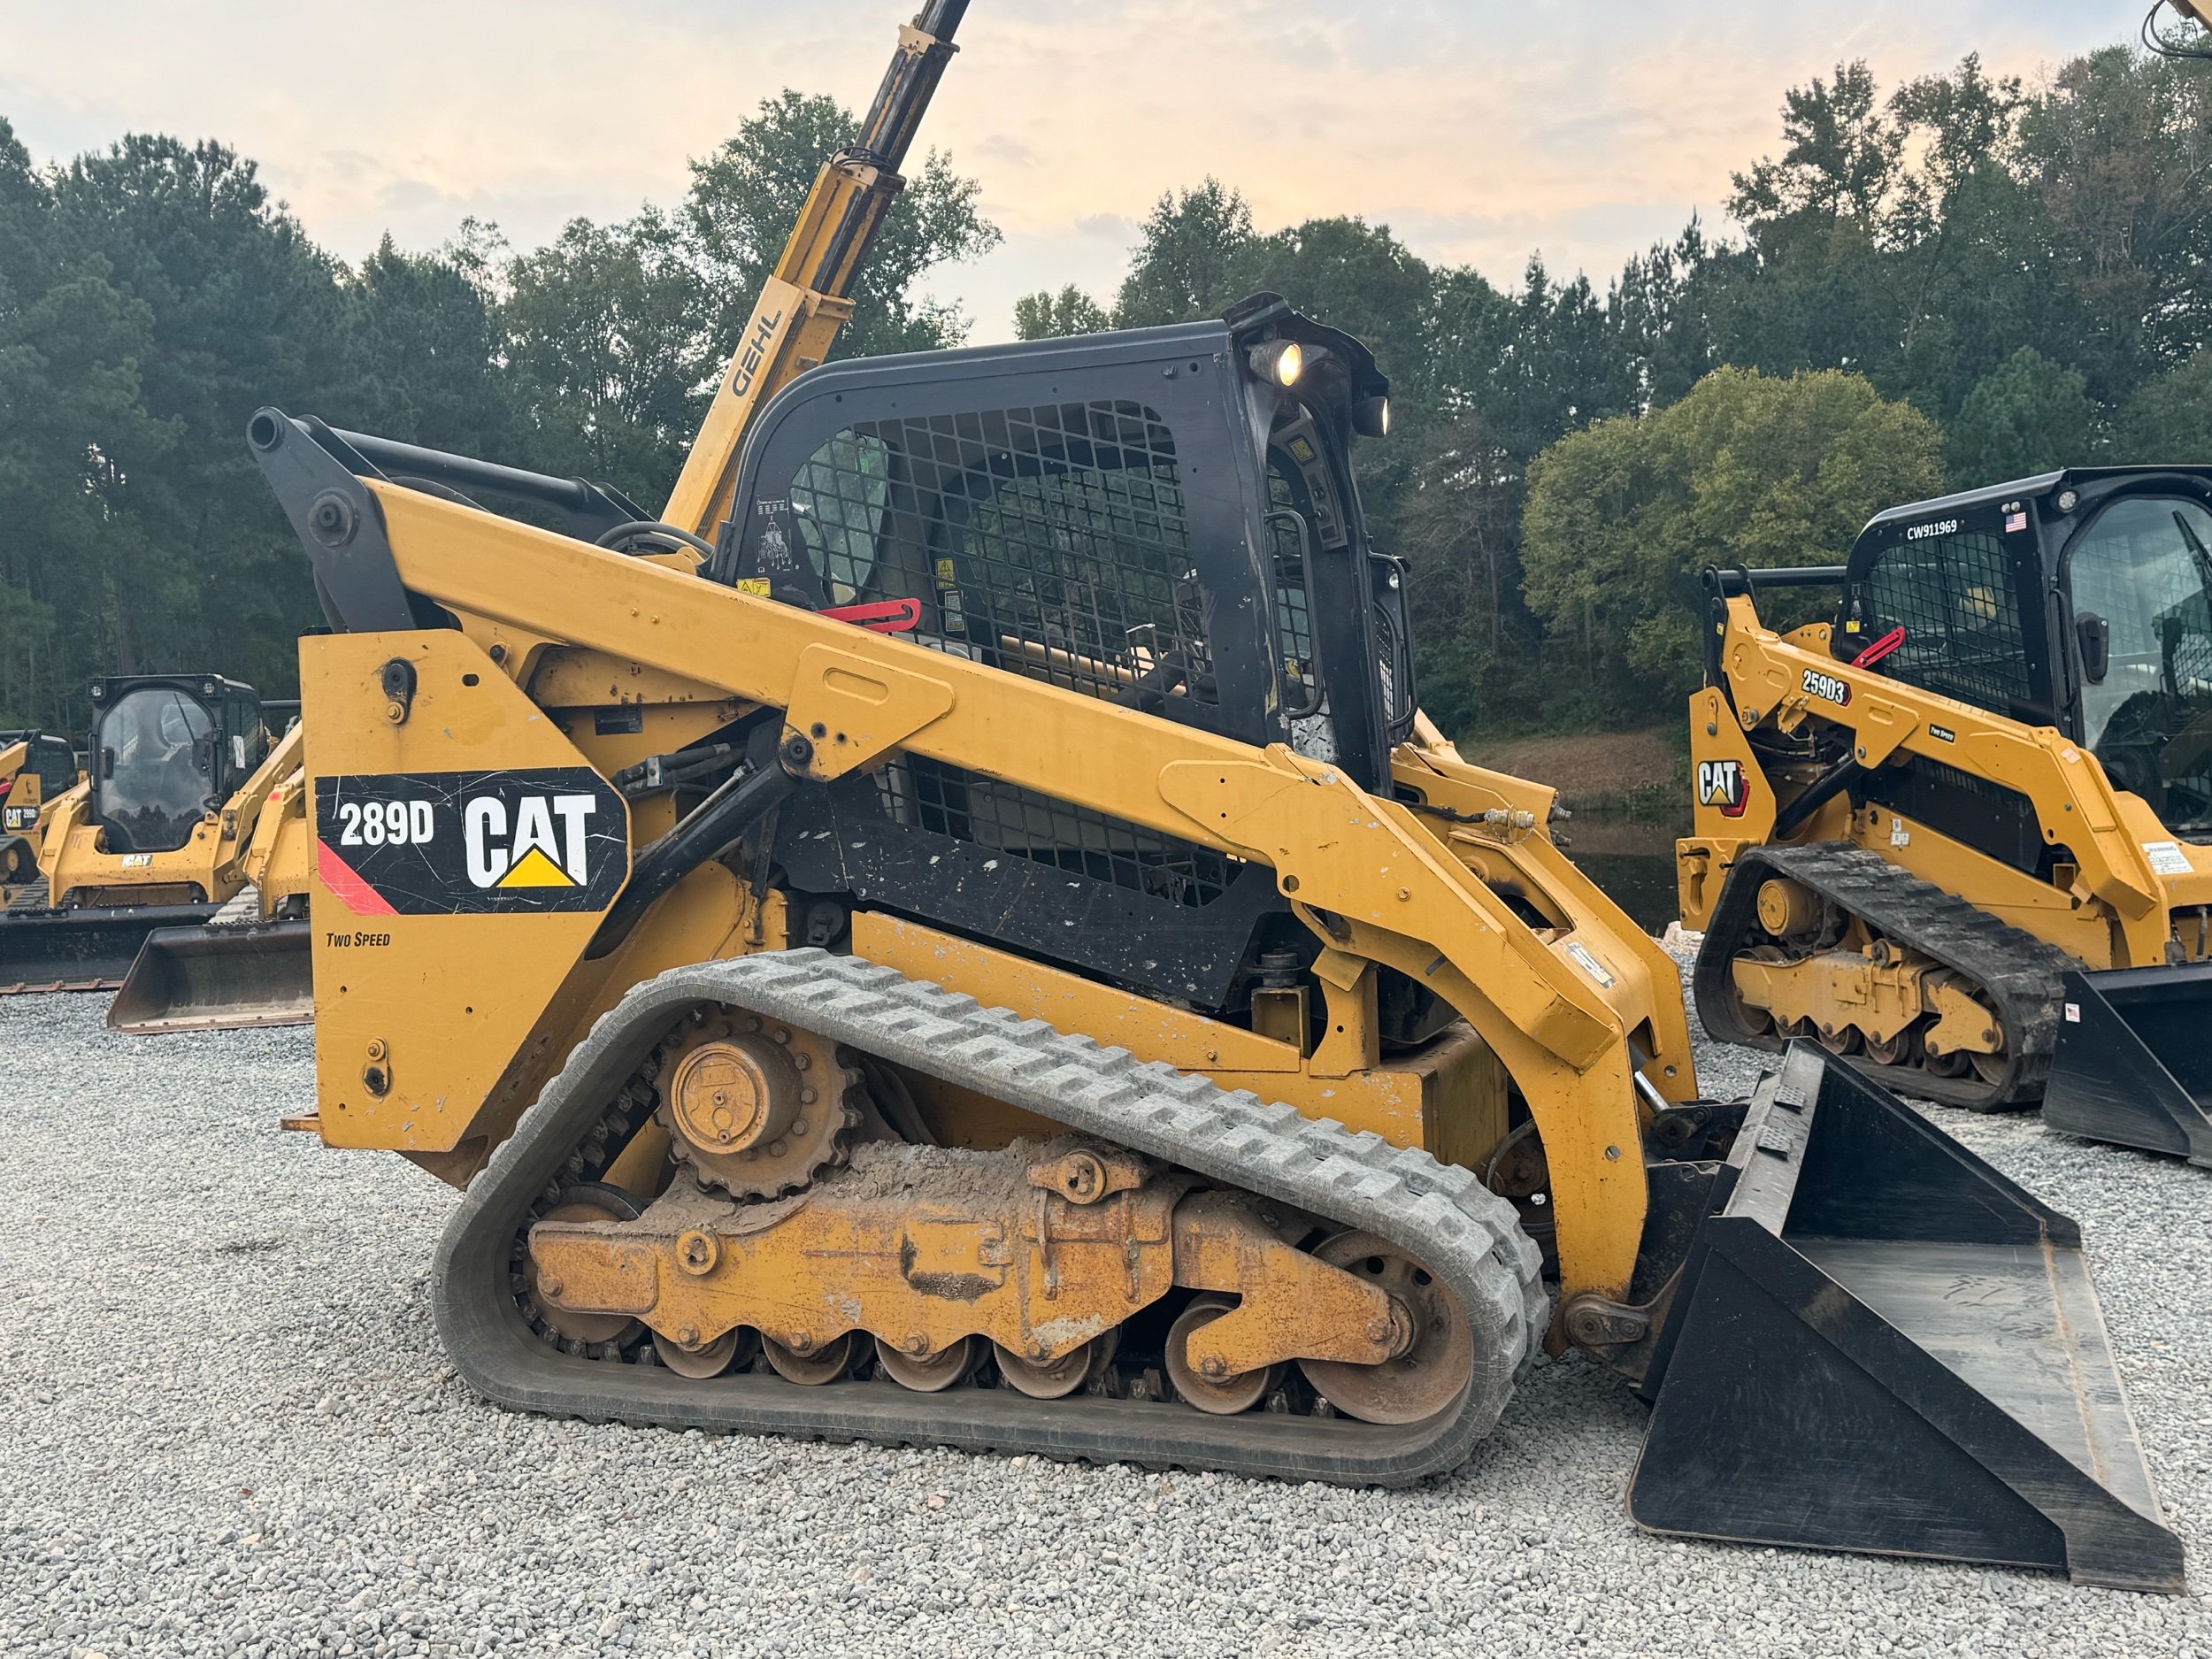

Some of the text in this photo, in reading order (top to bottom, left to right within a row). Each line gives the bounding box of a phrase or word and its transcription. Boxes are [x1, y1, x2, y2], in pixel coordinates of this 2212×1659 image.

[733, 310, 782, 397] GEHL
[1907, 518, 1957, 541] CW911969
[1802, 669, 1846, 704] 259D3
[1699, 761, 1736, 804] CAT
[5, 808, 22, 827] CAT
[340, 800, 434, 846] 289D
[465, 794, 596, 888] CAT
